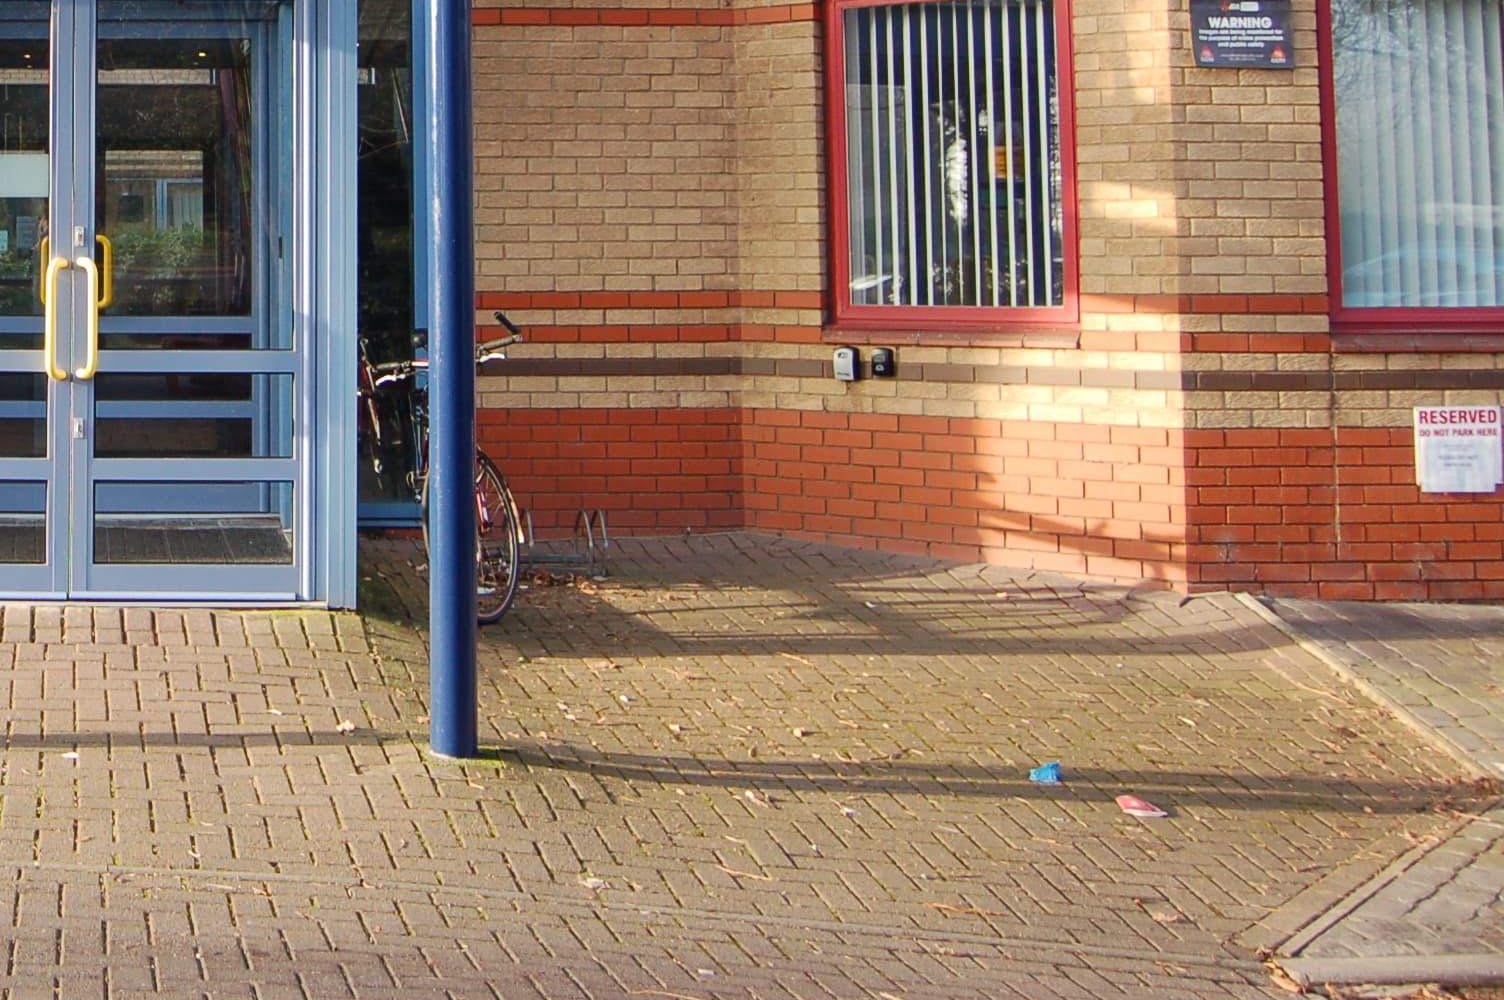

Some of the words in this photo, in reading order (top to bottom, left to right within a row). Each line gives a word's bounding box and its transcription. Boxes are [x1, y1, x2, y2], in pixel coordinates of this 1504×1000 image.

[1207, 16, 1272, 29] WARNING
[1418, 409, 1497, 425] RESERVED
[1419, 428, 1431, 438] DO
[1433, 428, 1449, 437] NOT
[1452, 428, 1474, 437] PARK
[1476, 427, 1498, 437] HERE
